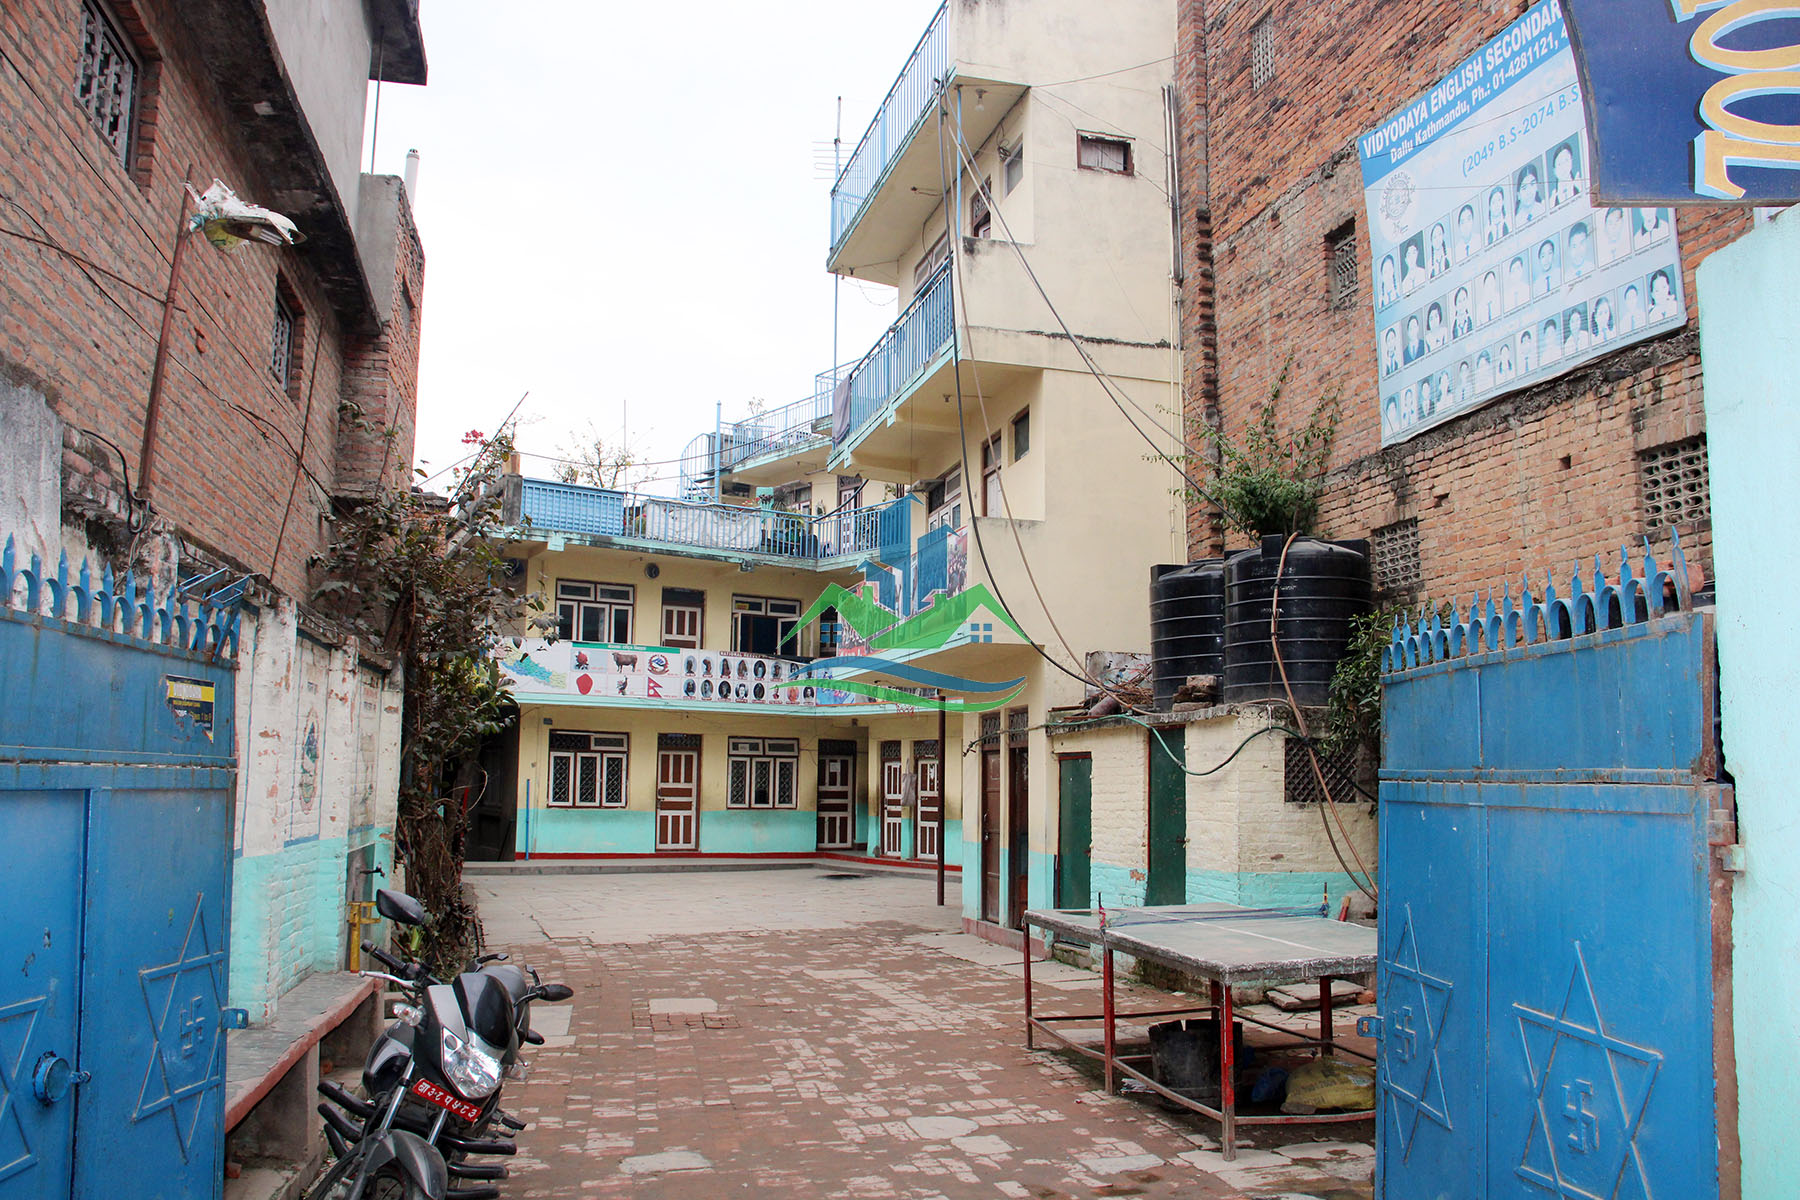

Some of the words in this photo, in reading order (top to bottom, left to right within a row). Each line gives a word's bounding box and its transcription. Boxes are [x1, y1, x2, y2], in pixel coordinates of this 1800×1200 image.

[1363, 100, 1428, 159] VIDYODAYA
[1430, 56, 1484, 114] ENGLISH
[1390, 139, 1414, 164] Dallu
[1414, 100, 1470, 146] Kathmandu,
[1471, 82, 1491, 106] Ph.:
[1492, 31, 1559, 90] 01-4281121,
[1462, 141, 1495, 178] (2049
[1498, 101, 1554, 151] B.S-2074
